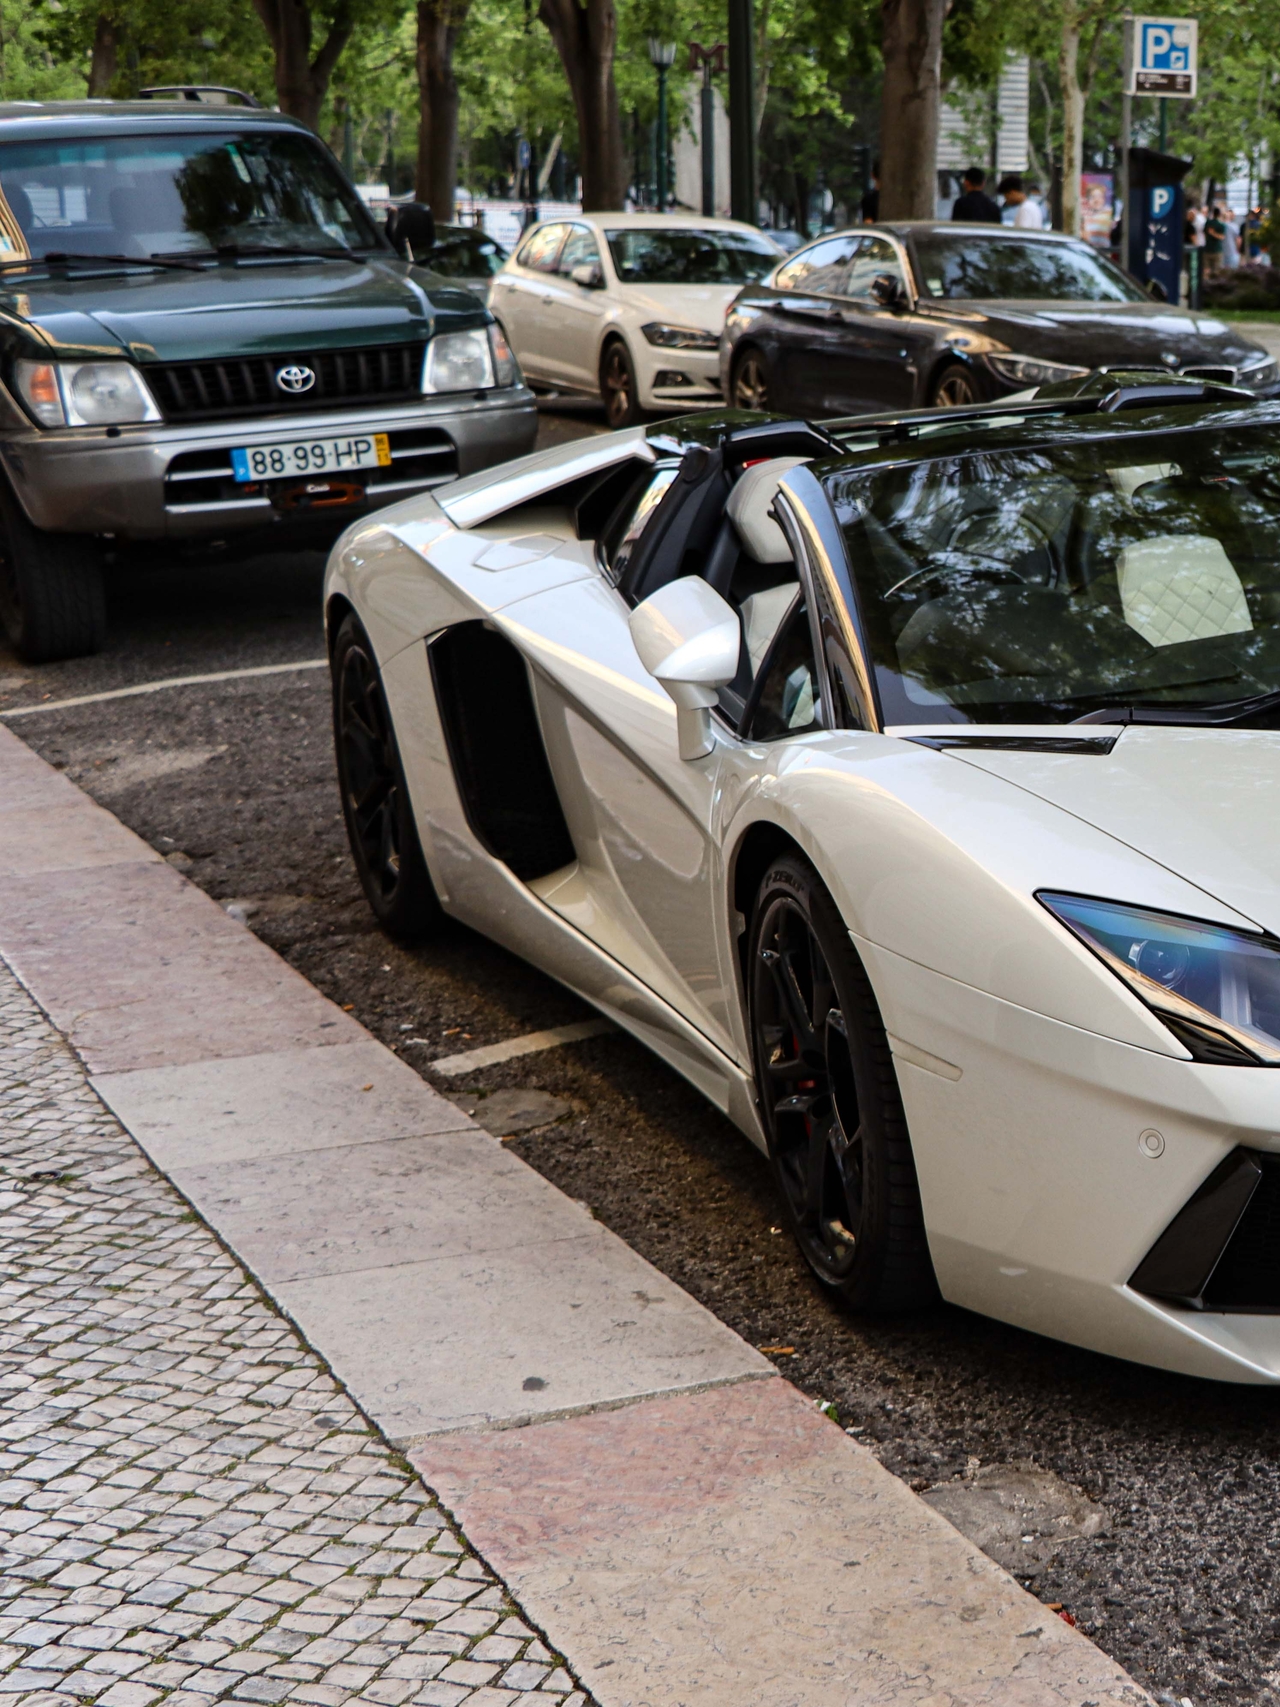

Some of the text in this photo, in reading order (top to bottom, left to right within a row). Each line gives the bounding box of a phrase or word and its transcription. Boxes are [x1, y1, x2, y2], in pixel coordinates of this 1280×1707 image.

[688, 42, 729, 71] M
[1146, 26, 1171, 67] P
[1153, 186, 1169, 213] P
